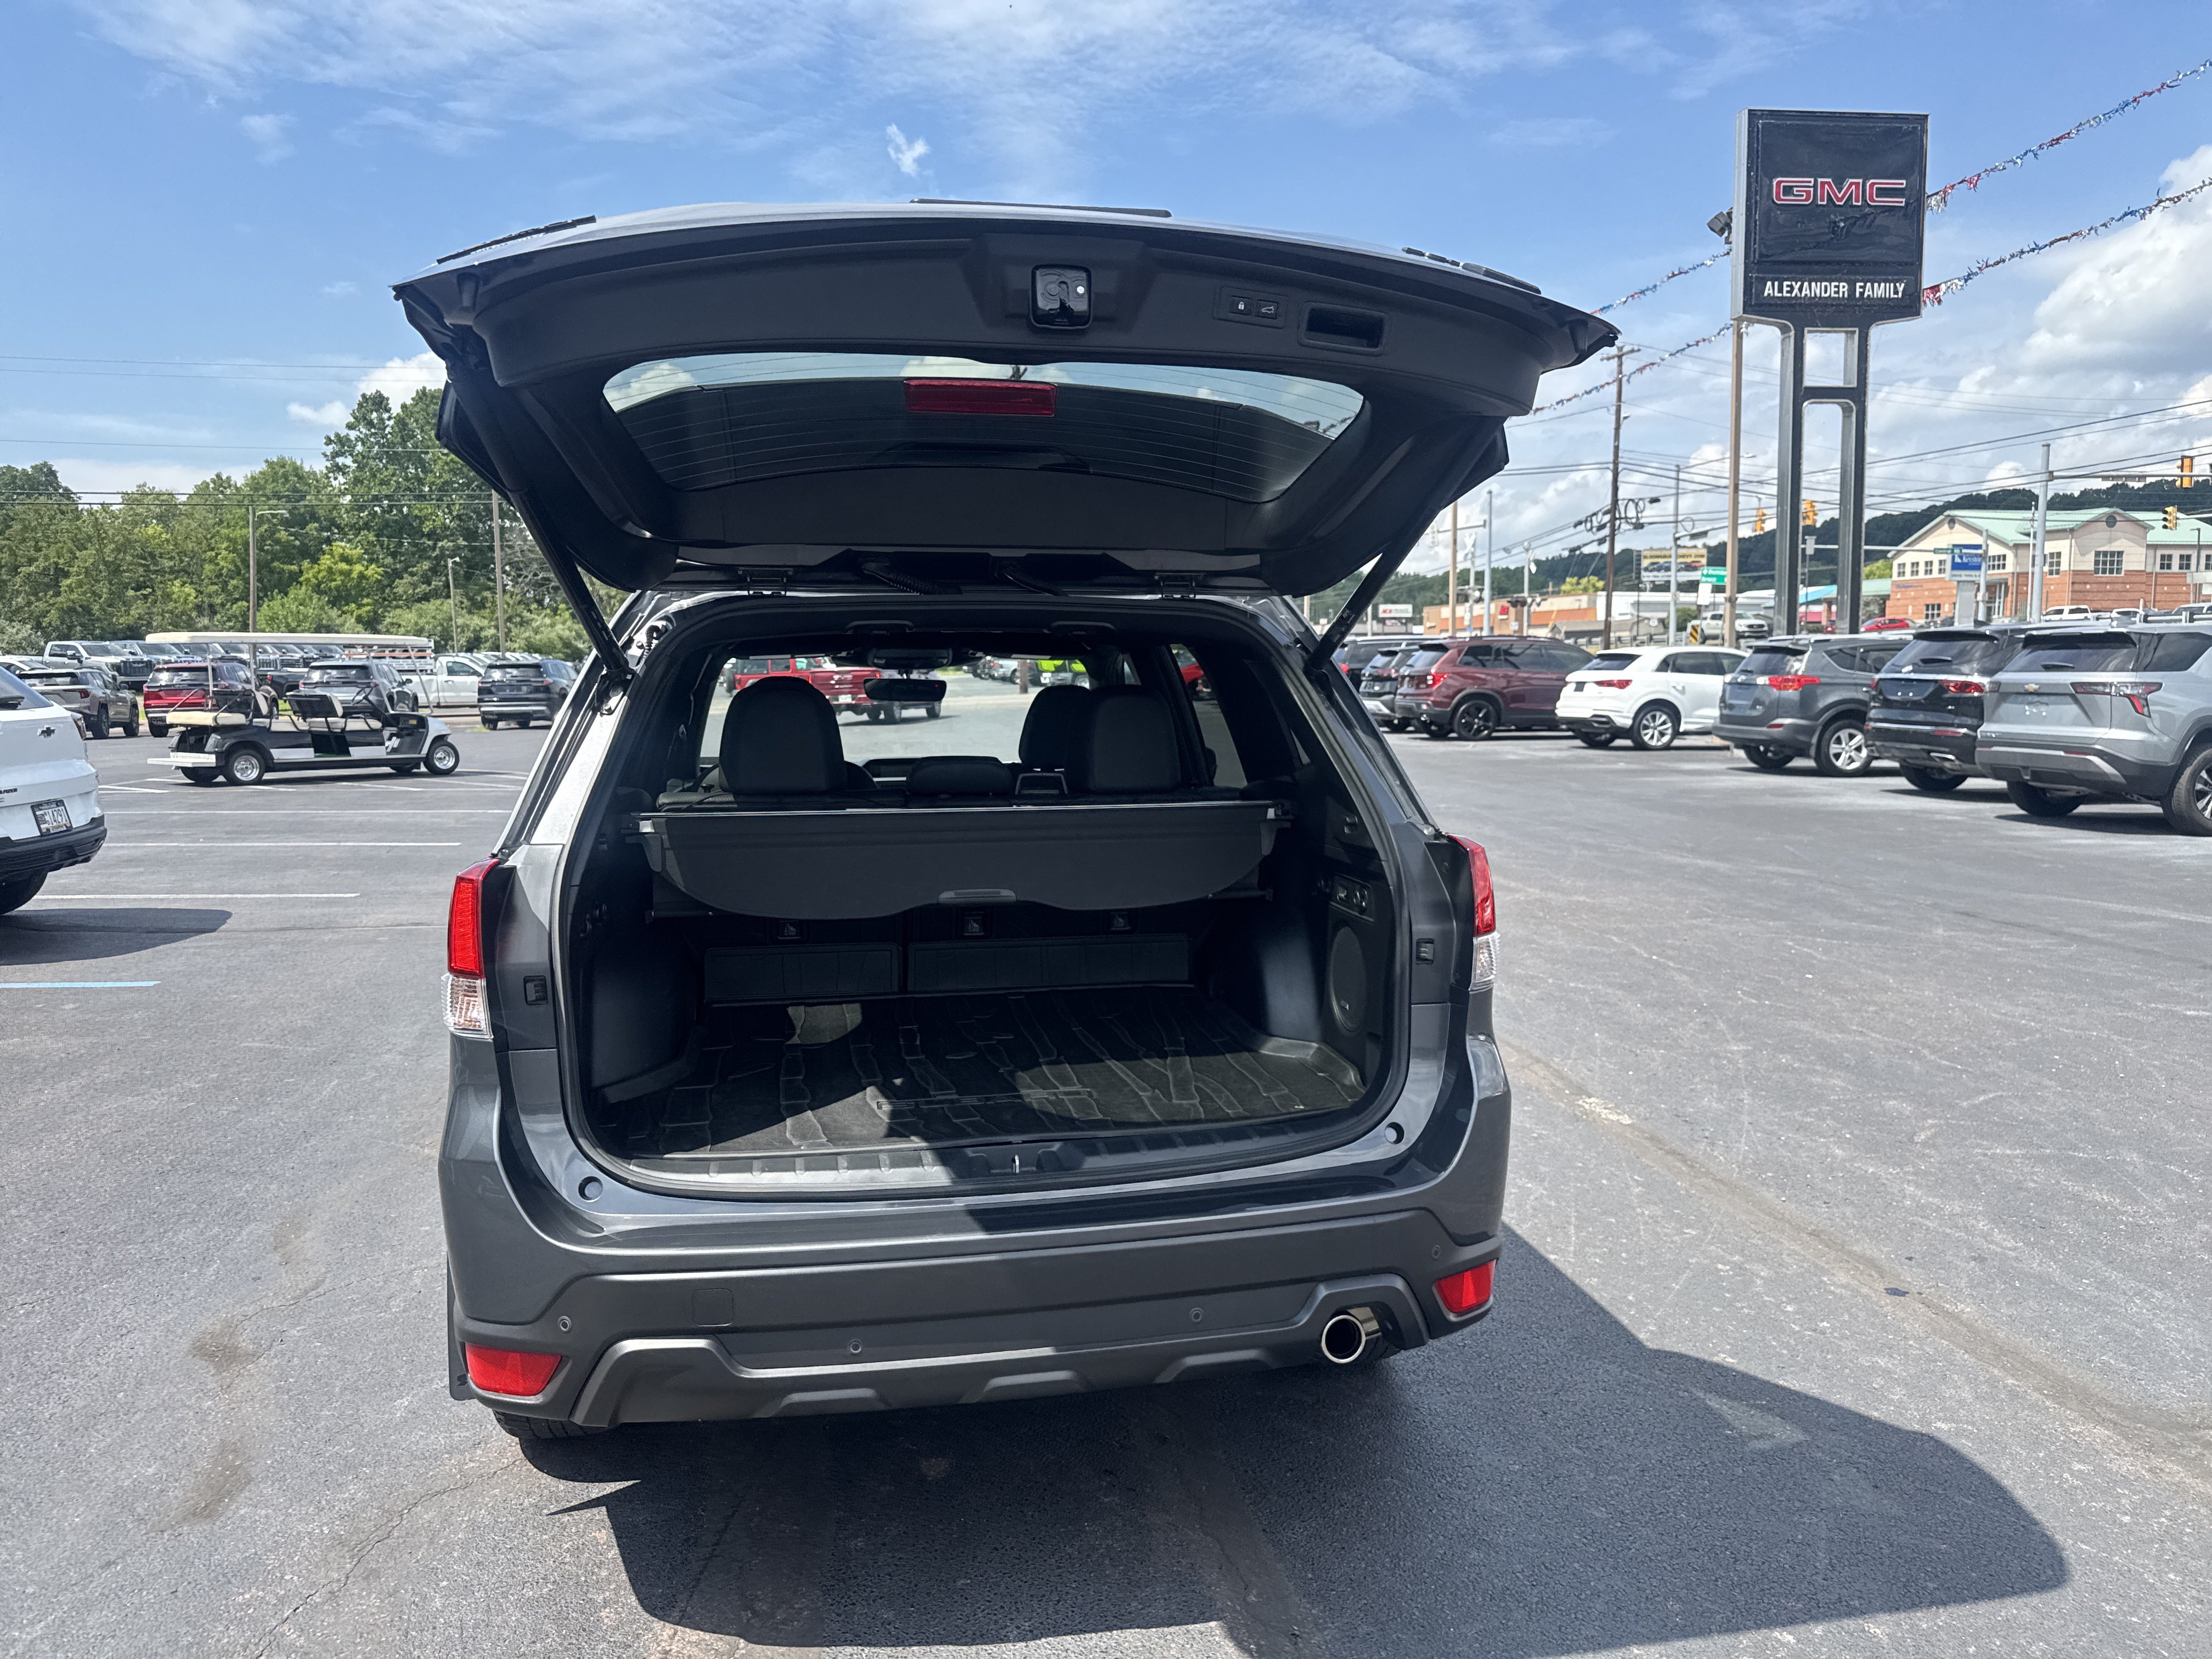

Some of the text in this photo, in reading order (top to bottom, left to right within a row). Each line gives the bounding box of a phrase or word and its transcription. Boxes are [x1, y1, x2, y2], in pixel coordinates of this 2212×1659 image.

[1773, 178, 1906, 206] GMC
[1764, 280, 1905, 298] ALEXANDER FAMILY
